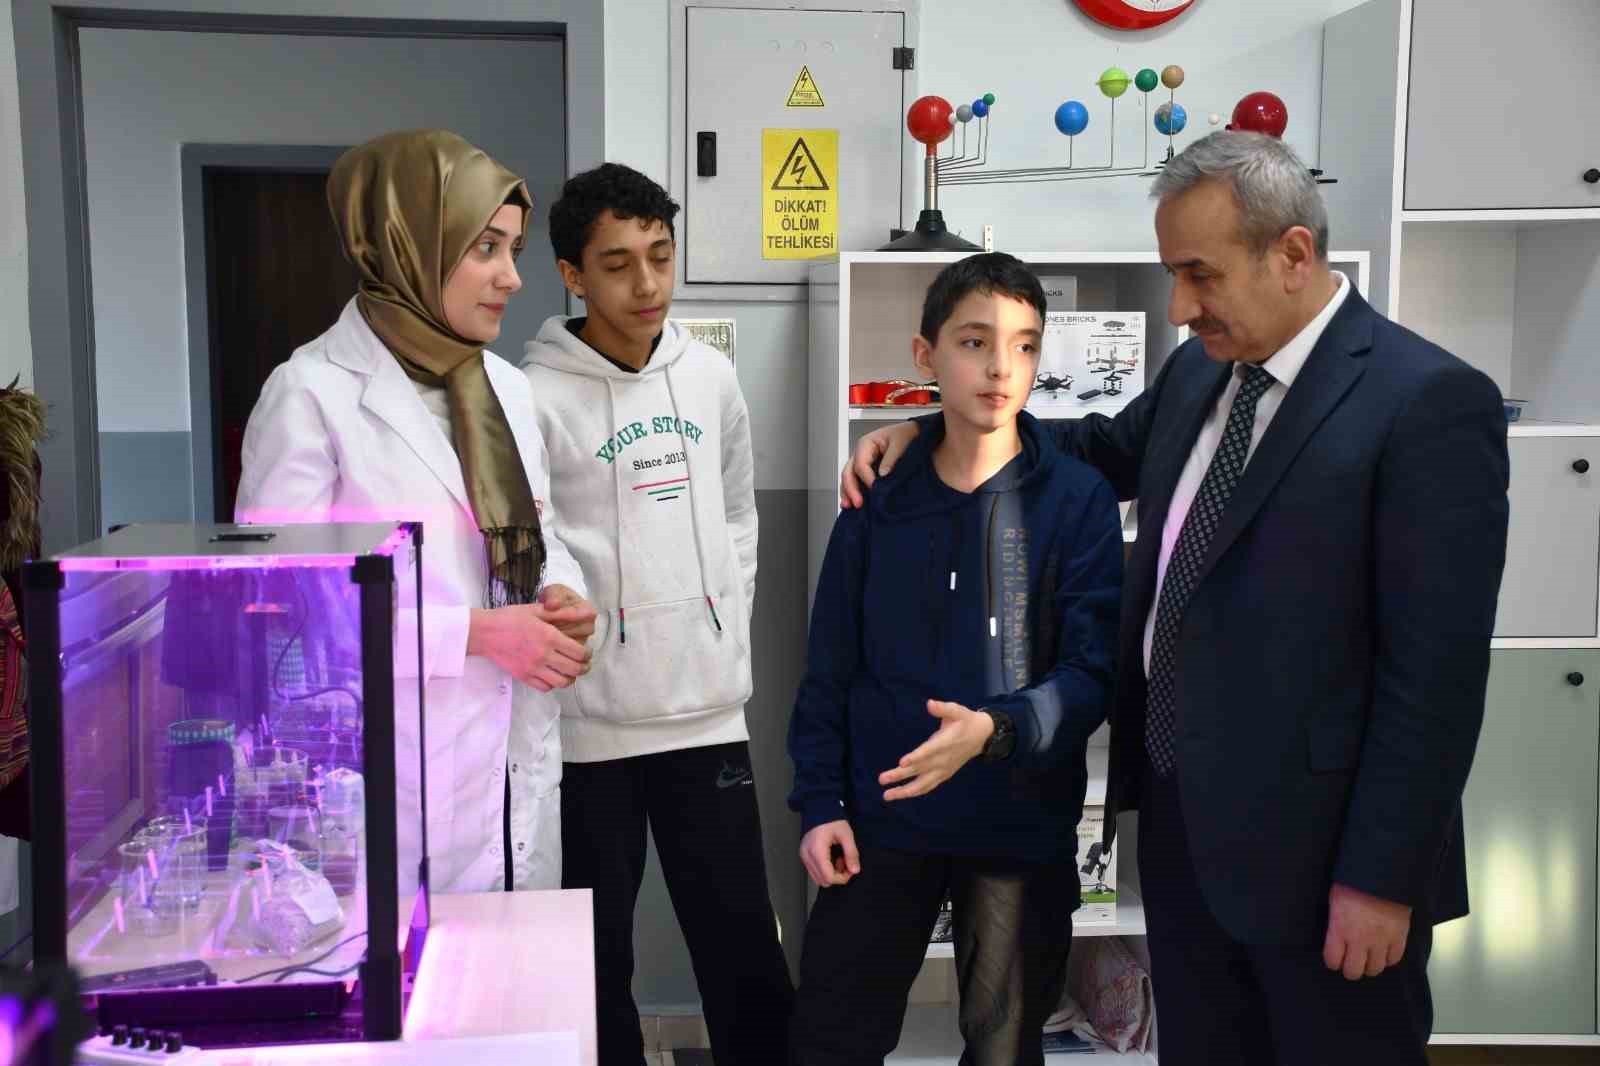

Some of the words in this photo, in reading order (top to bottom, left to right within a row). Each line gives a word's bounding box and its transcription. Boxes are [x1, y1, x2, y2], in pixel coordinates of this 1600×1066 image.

[774, 197, 826, 213] DİKKAT!
[781, 214, 819, 231] ÖLÜM
[766, 233, 834, 249] TEHLİKESİ
[595, 421, 648, 464] YOUR
[652, 415, 704, 446] STORY
[632, 458, 662, 471] Since
[664, 451, 687, 465] 2013
